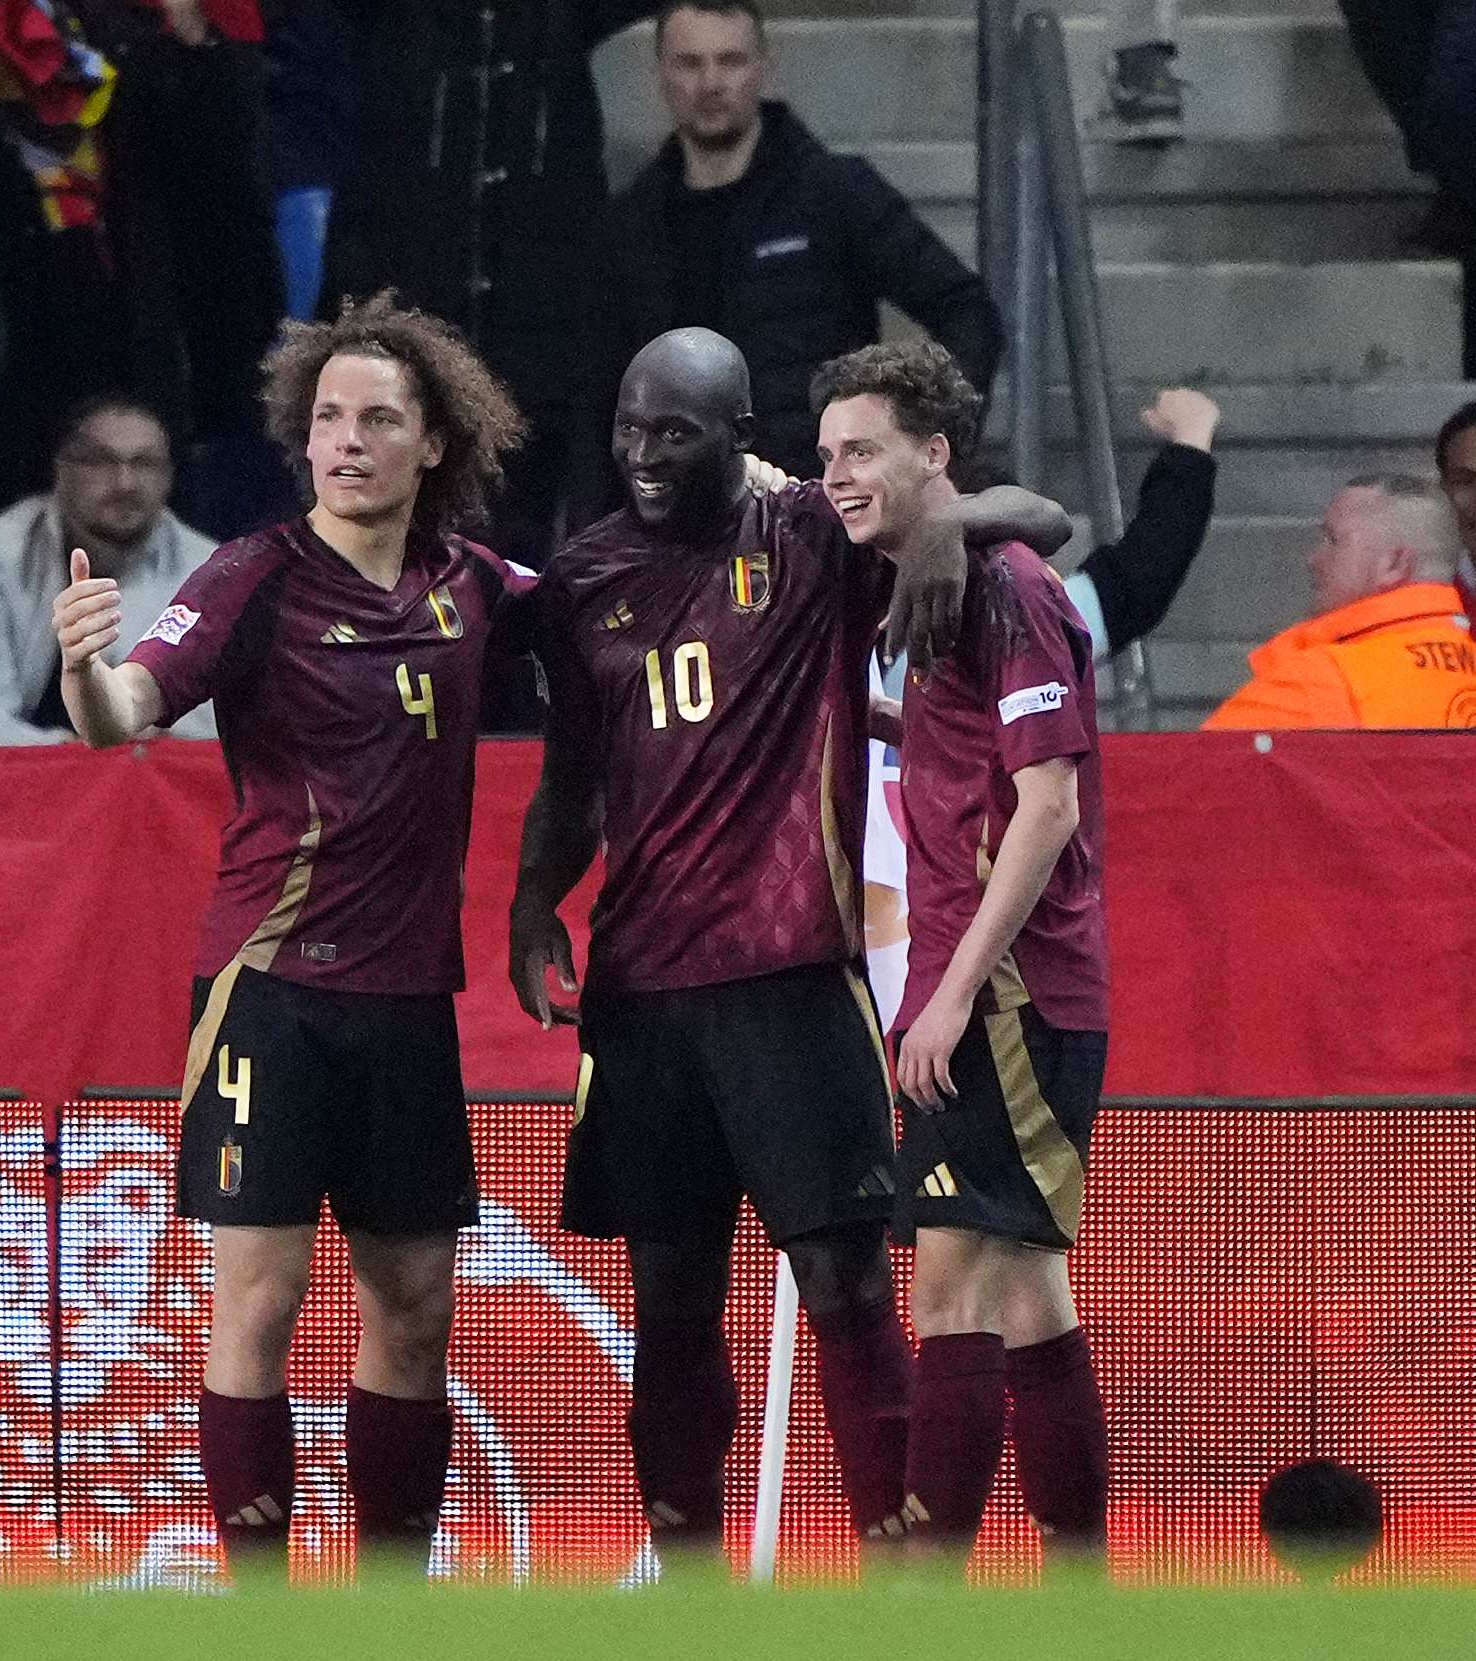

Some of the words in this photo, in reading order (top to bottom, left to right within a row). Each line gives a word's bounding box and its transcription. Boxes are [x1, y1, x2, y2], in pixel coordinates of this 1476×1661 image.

[395, 663, 438, 740] 4
[645, 640, 714, 729] 10
[217, 1044, 251, 1125] 4
